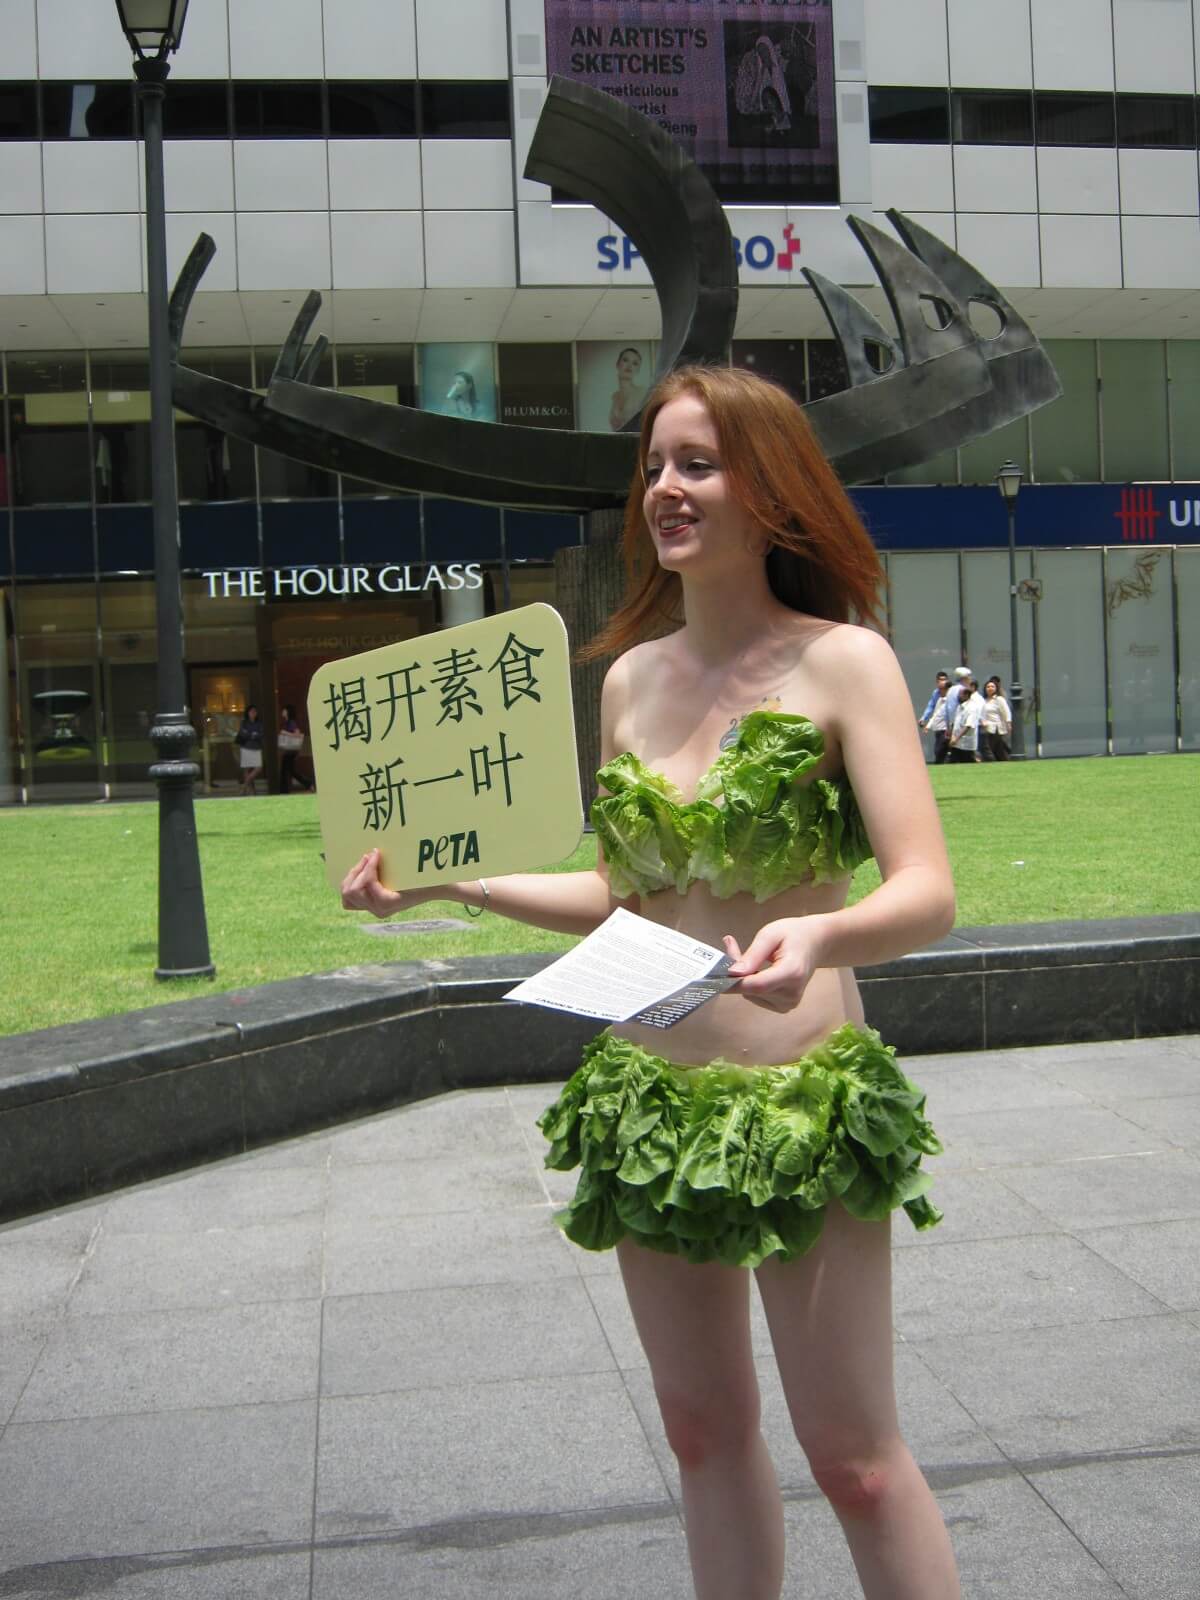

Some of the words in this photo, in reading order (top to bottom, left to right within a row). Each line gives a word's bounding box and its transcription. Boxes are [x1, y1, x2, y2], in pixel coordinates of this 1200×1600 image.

[570, 27, 602, 47] AN
[609, 27, 708, 48] ARTIST'S
[571, 53, 686, 74] SKETCHES
[202, 571, 266, 598] THE
[274, 567, 373, 596] HOUR
[378, 563, 484, 593] GLASS
[323, 632, 545, 751] 揭开素食
[359, 731, 524, 832] 新一叶
